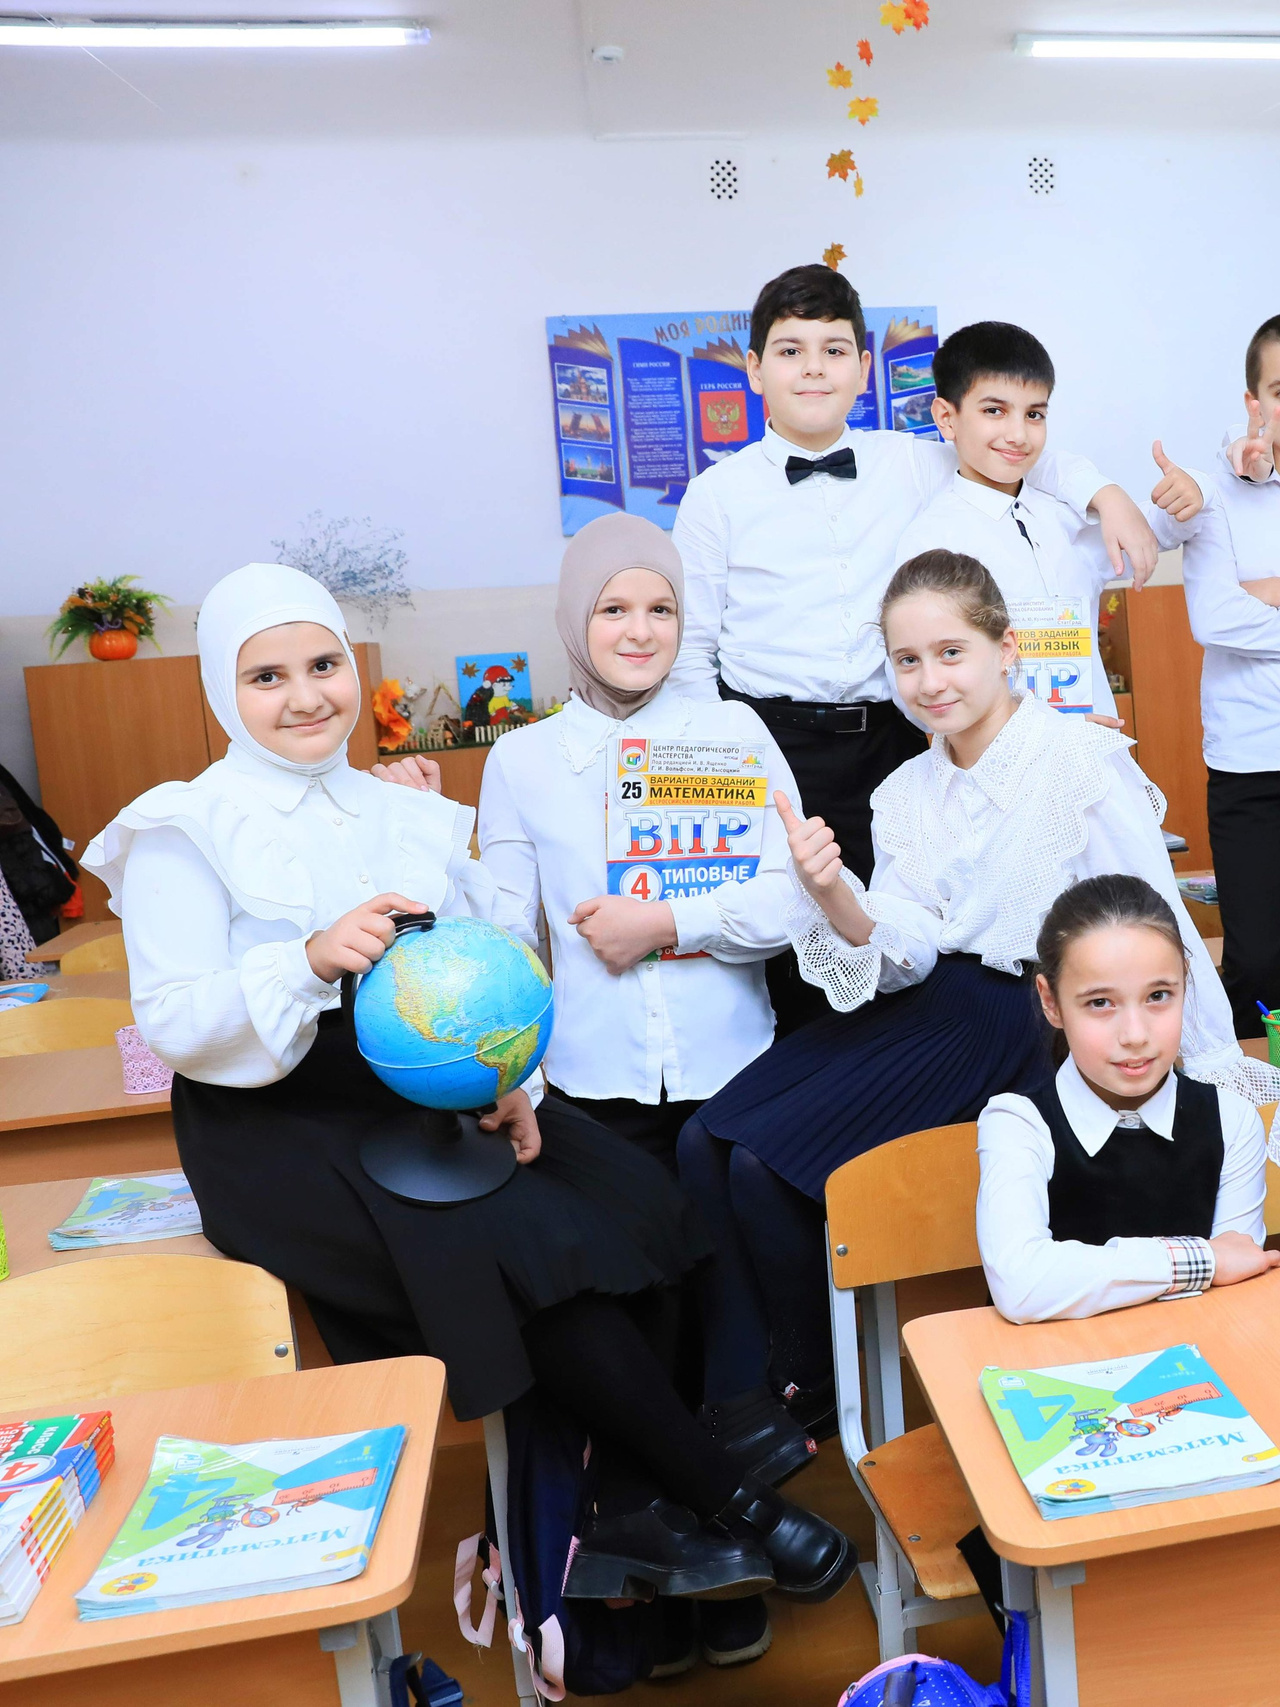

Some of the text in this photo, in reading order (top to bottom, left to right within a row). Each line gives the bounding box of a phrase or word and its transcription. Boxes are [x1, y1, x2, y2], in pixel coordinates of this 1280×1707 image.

[654, 313, 752, 344] МОЯ РОДИН
[1038, 629, 1079, 639] ЗАДАНИЙ
[1044, 641, 1080, 651] ЯЗЫК
[676, 745, 740, 754] ПЕДАГОГИЧЕСКОГО
[621, 781, 642, 800] 25
[650, 776, 756, 787] ВАРИАНТОВ ЗАДАНИЙ
[650, 786, 756, 800] МАТЕМАТИКА
[623, 809, 752, 858] ВПР
[662, 865, 750, 885] ТИПОВЫЕ
[631, 872, 651, 900] 4
[996, 1388, 1076, 1442] 4
[1054, 1430, 1248, 1476] Математика
[1, 1462, 39, 1480] 4
[141, 1472, 237, 1531] 4
[137, 1524, 352, 1568] Математика
